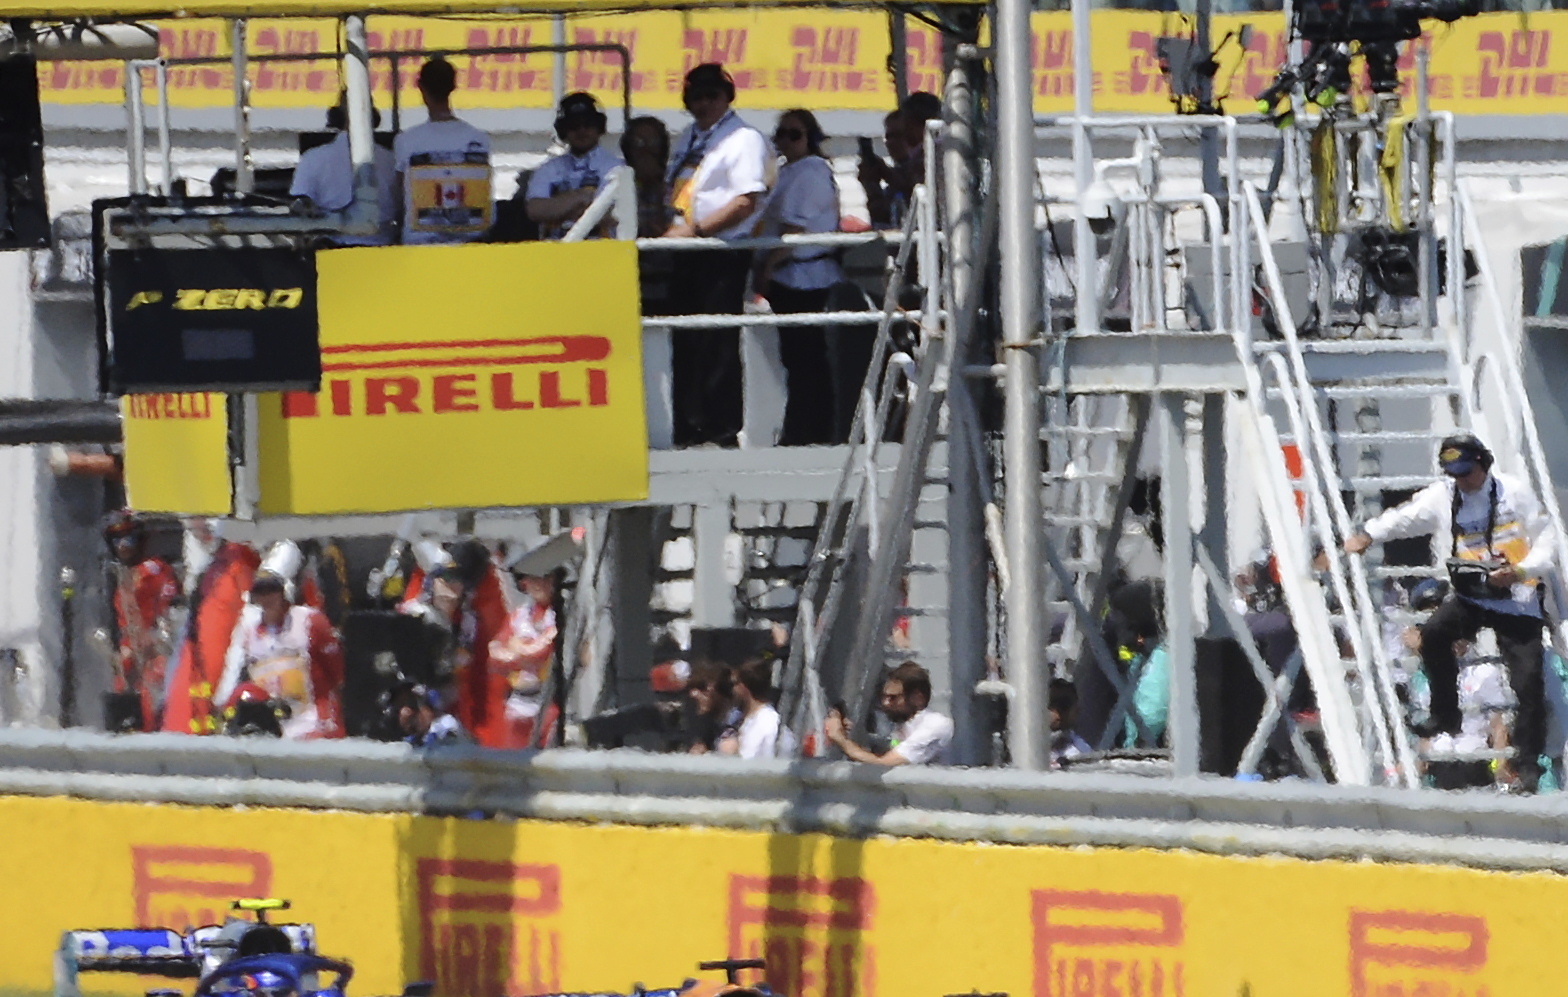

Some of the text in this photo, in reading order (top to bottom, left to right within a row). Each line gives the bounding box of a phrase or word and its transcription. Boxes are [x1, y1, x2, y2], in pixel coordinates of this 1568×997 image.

[791, 27, 864, 92] DHL
[1478, 30, 1556, 99] DHL
[173, 287, 303, 311] ZERO
